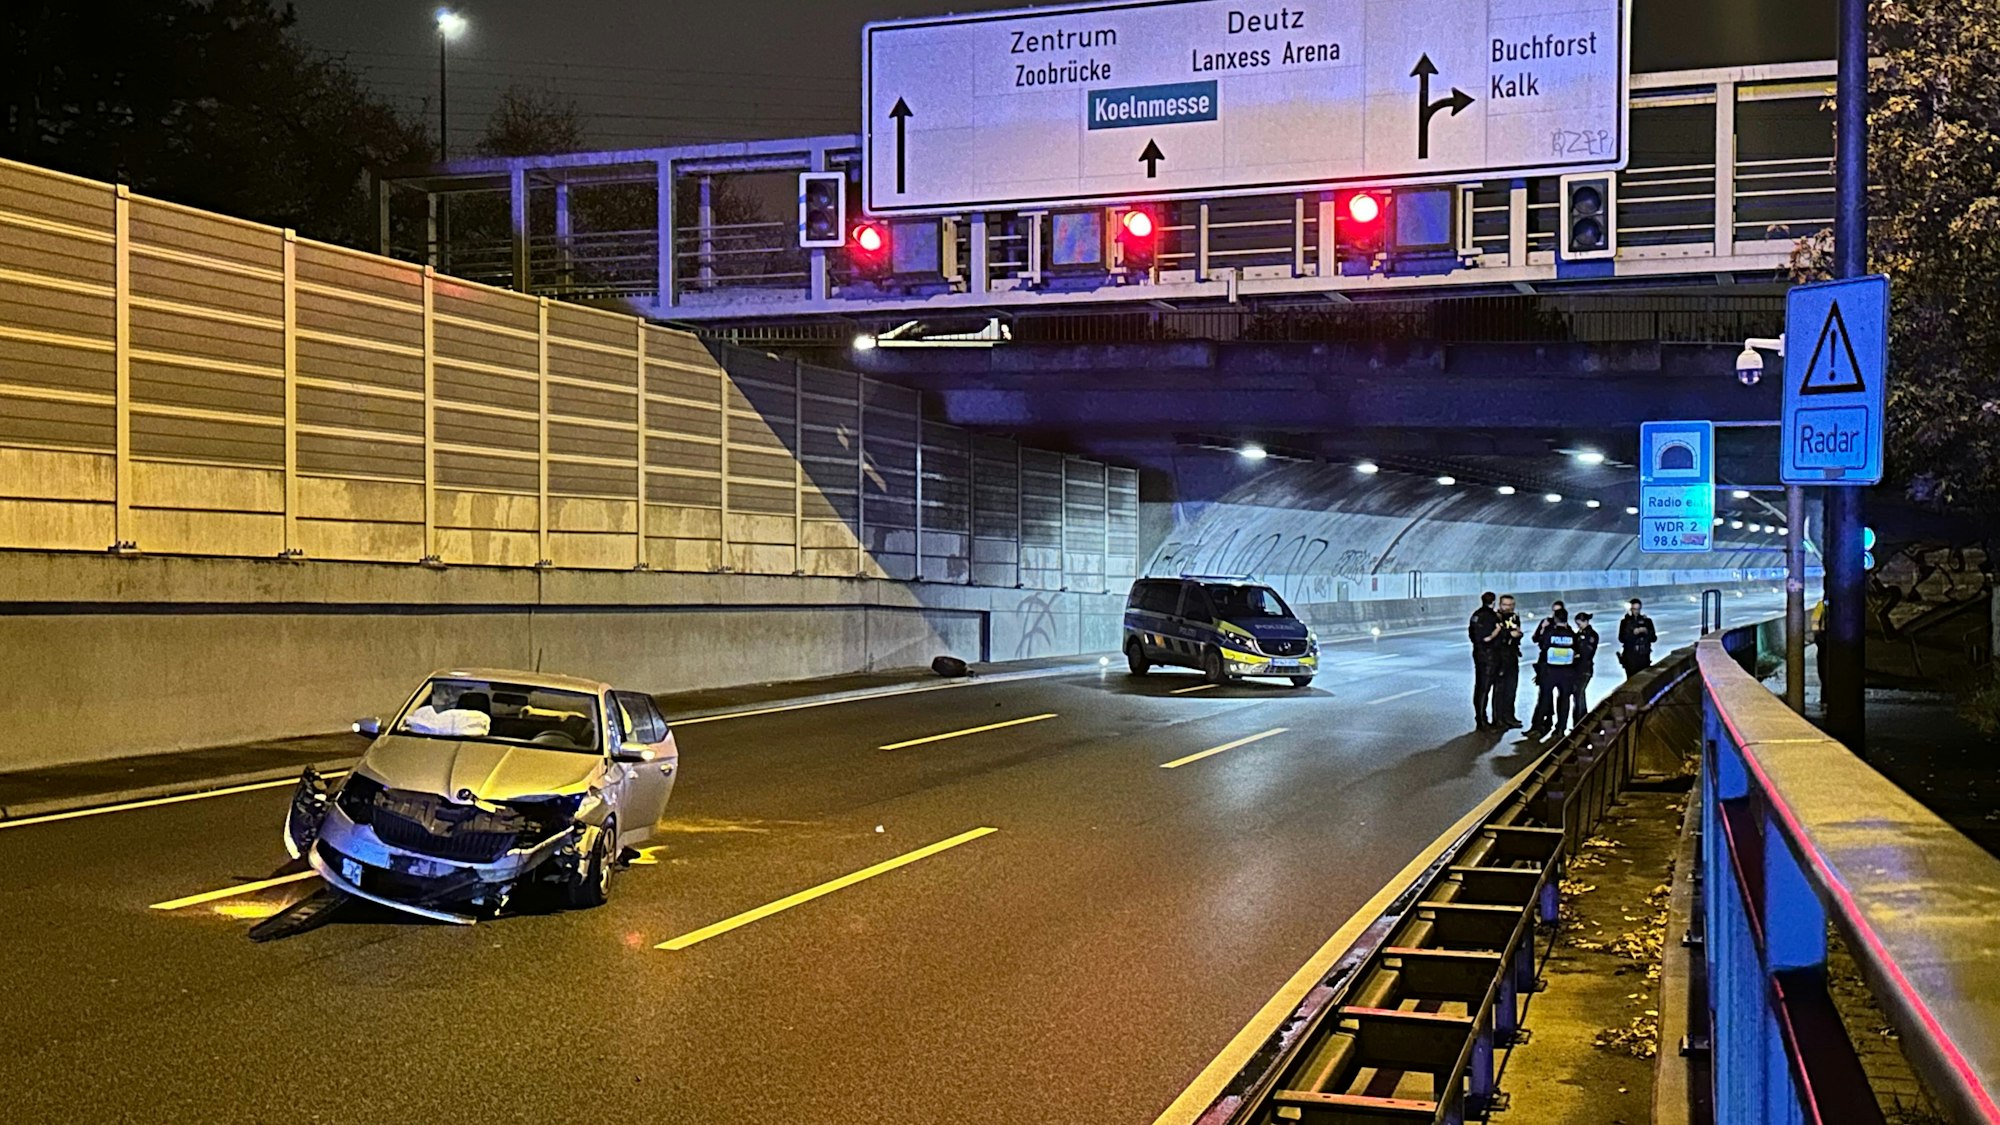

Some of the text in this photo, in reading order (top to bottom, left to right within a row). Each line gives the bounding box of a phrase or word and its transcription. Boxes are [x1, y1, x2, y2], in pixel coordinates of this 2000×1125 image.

[1228, 8, 1304, 34] Deutz
[1011, 29, 1116, 54] Zentrum
[1492, 32, 1597, 62] Buchforst
[1192, 41, 1340, 72] Lanxess Arena
[1015, 59, 1111, 87] Zoobrücke
[1491, 72, 1539, 99] Kalk
[1095, 95, 1209, 121] Koelnmesse
[1801, 423, 1859, 453] Radar
[1648, 497, 1682, 507] Radio
[1654, 521, 1698, 532] WDR 2
